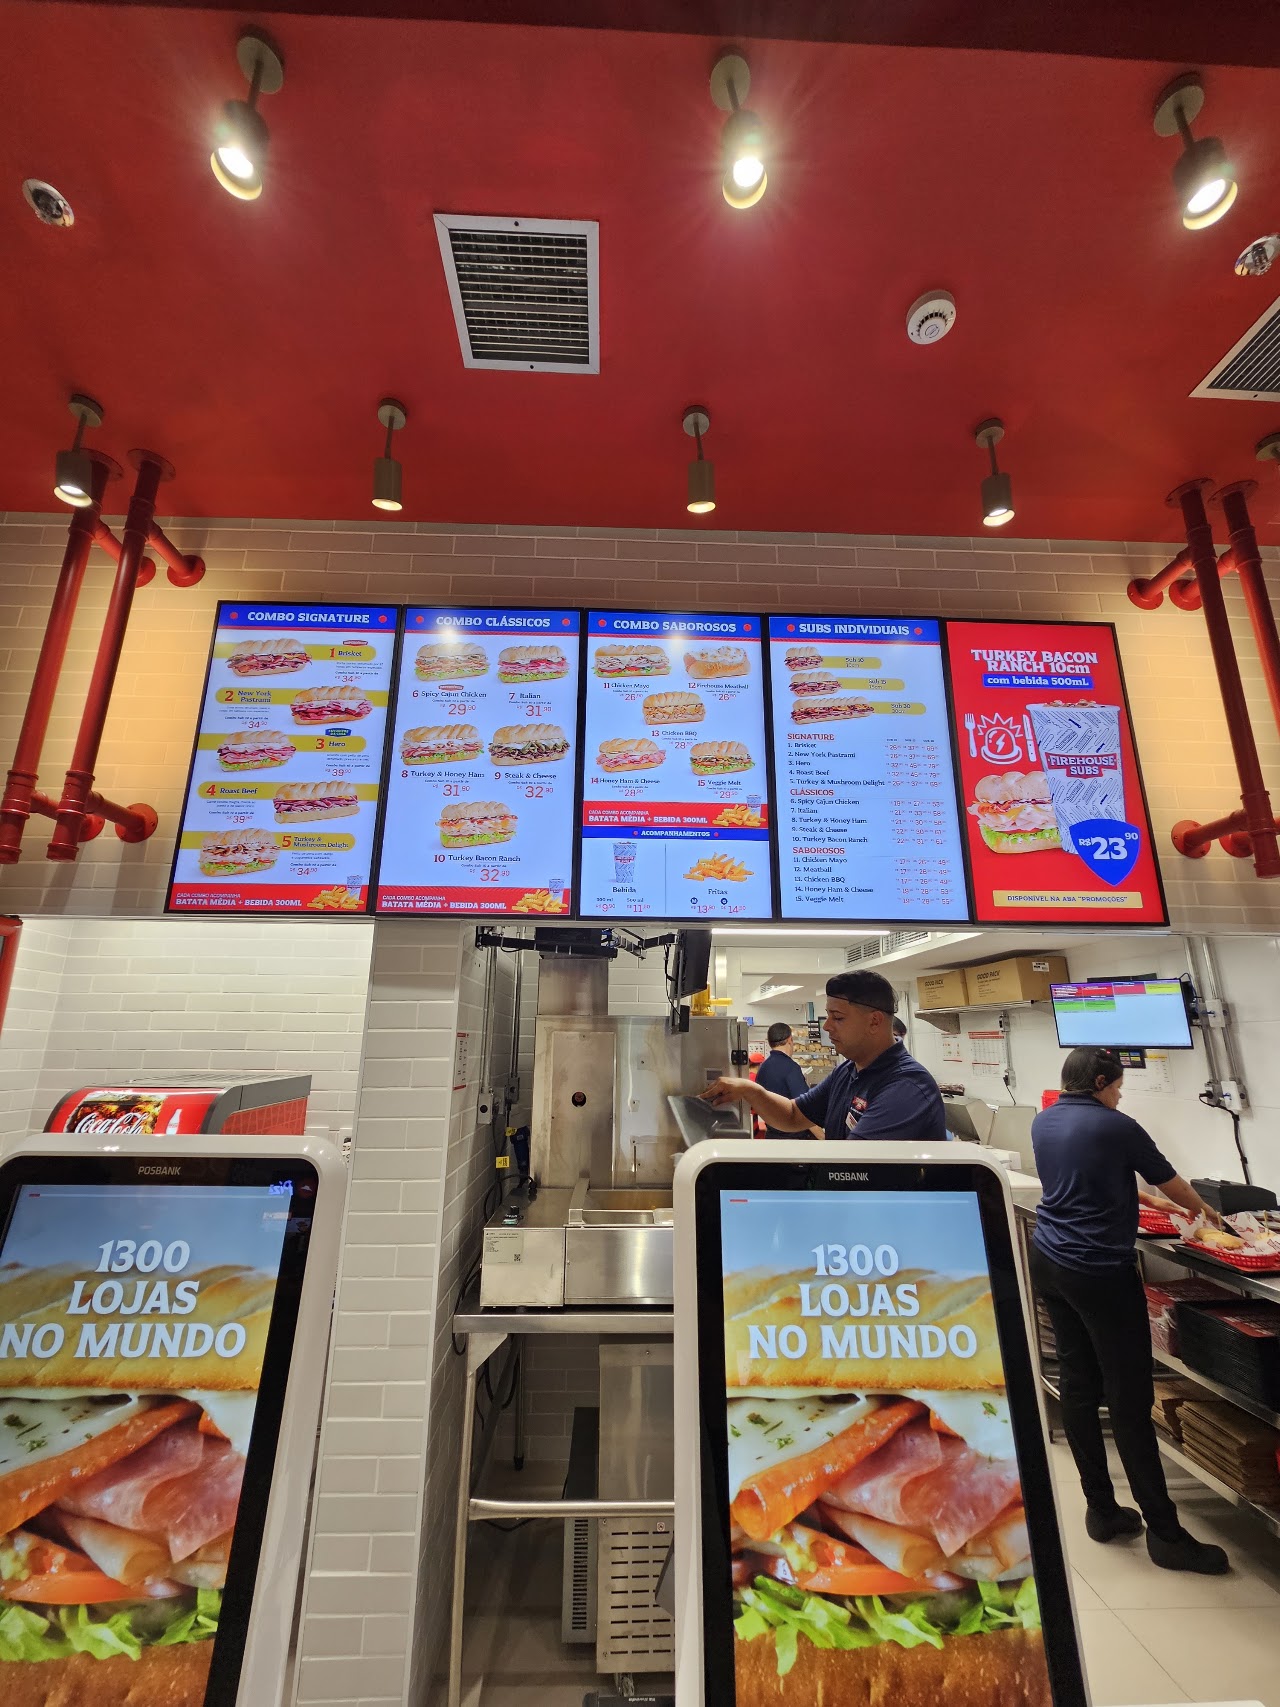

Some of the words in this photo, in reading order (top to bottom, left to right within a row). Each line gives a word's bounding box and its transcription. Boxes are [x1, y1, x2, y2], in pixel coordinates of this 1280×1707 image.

[247, 611, 295, 622] COMBO
[298, 612, 370, 623] SIGNATURE
[436, 616, 482, 626] COMBO
[485, 615, 551, 627] CLÁSSICOS
[613, 620, 660, 630] COMBO
[662, 621, 737, 632] SABOROSOS
[799, 623, 831, 633] SUBS
[834, 624, 910, 635] INDIVIDUAIS
[330, 648, 335, 658] 1
[970, 649, 1037, 662] TURKEY
[1041, 651, 1099, 664] BACON
[987, 661, 1045, 673] RANCH
[1049, 662, 1091, 674] 10cm
[987, 676, 1010, 685] com
[1012, 675, 1049, 686] bebida
[225, 690, 234, 702] 2
[412, 690, 418, 698] 6
[316, 738, 325, 750] 3
[1050, 755, 1116, 766] FIREHOUSE
[402, 770, 408, 778] 8
[494, 772, 500, 780] 9
[1070, 766, 1100, 776] SUBS
[206, 784, 216, 796] 4
[790, 788, 834, 796] CLÁSSICOS
[282, 836, 292, 848] 5
[1090, 836, 1128, 860] 23
[1124, 832, 1138, 840] 90
[792, 846, 845, 854] SABOROSOS
[434, 854, 446, 862] 10
[1007, 894, 1048, 902] DISPONÍVEL
[138, 1166, 181, 1176] POSBANK
[828, 1172, 869, 1182] POSBANK
[94, 1240, 190, 1274] 1300
[811, 1244, 899, 1277] 1300
[66, 1280, 200, 1316] LOJAS
[798, 1283, 920, 1318] LOJAS
[0, 1323, 65, 1359] NO
[73, 1323, 247, 1359] MUNDO
[747, 1324, 808, 1359] NO
[820, 1324, 978, 1359] MUNDO
